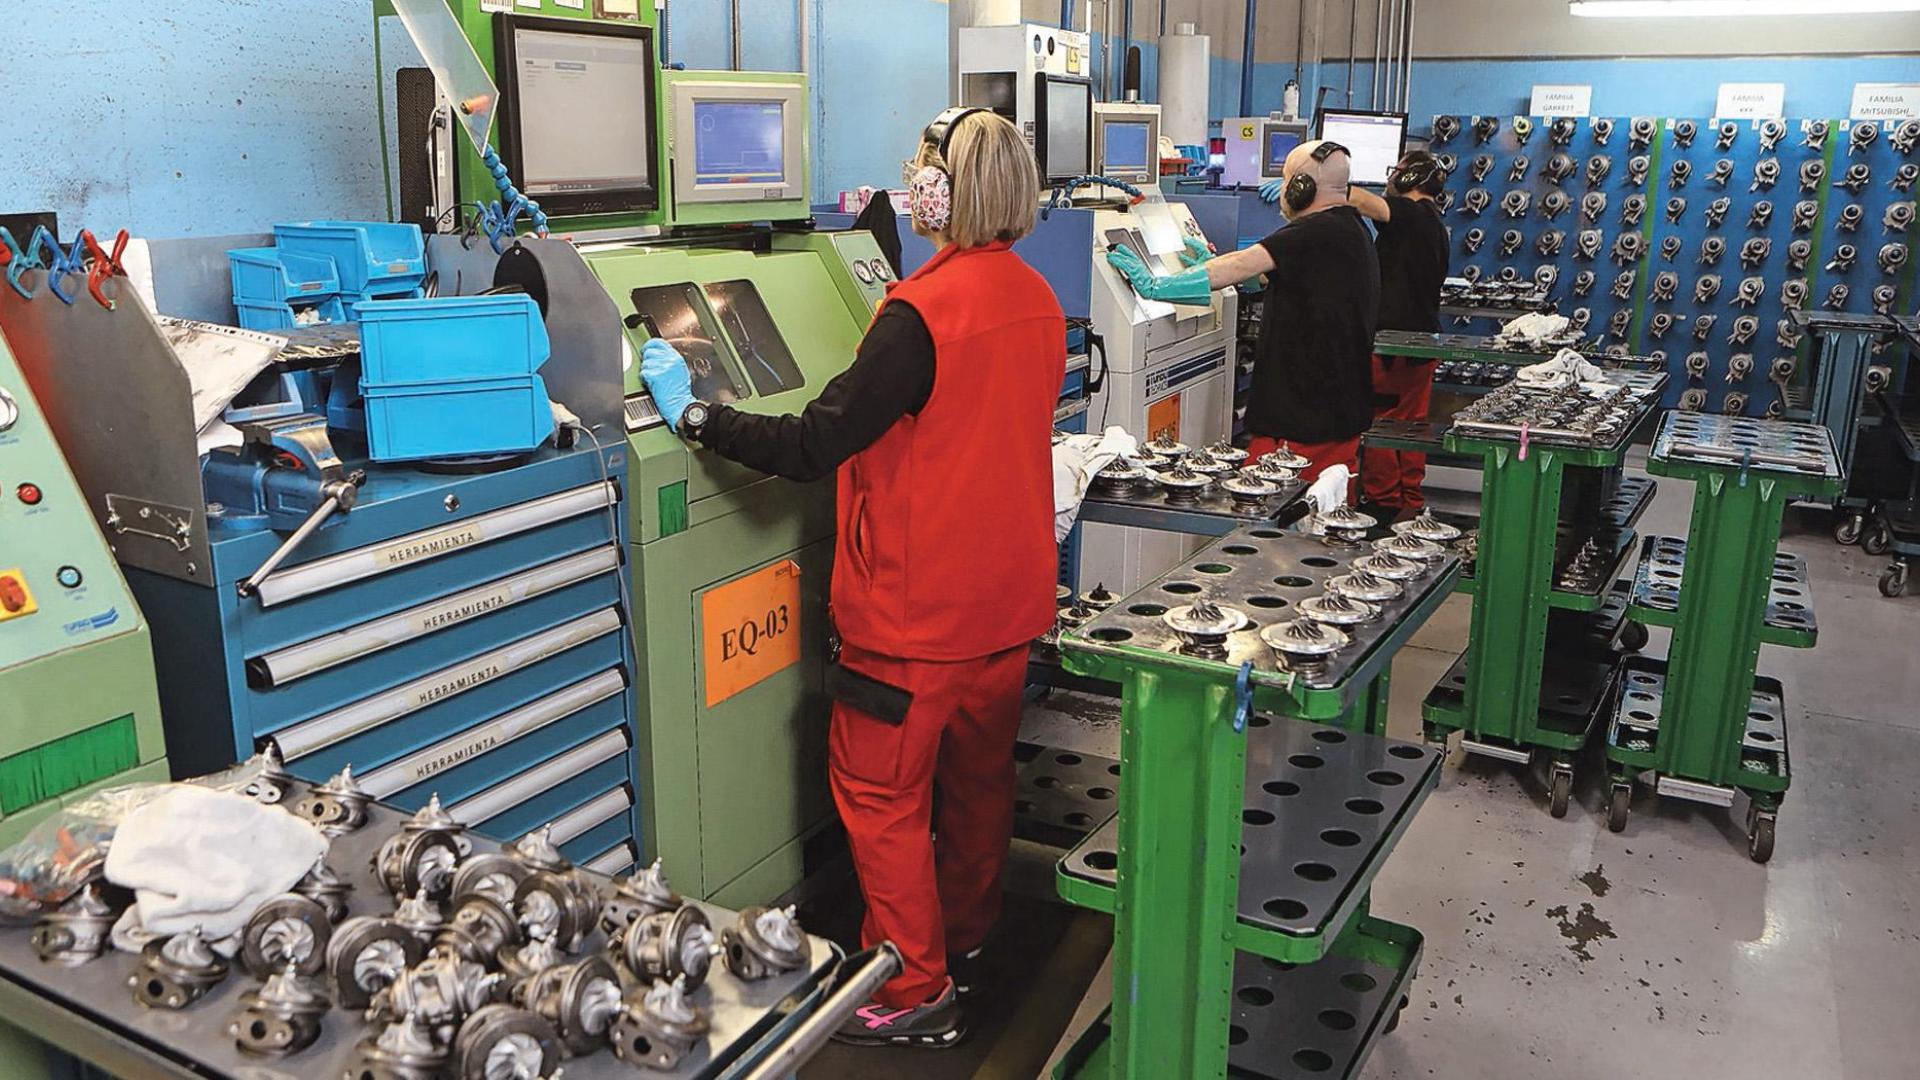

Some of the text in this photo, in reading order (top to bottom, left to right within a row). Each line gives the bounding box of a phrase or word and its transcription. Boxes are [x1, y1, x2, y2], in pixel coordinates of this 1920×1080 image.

[1859, 107, 1910, 116] MITSUBISHI
[1869, 95, 1904, 103] FAMILIA
[1242, 127, 1254, 137] CS
[388, 532, 475, 562] HERRAMIENTA
[423, 595, 505, 629] HERRAMIENTA
[721, 604, 789, 662] EQ-03
[418, 664, 500, 703] HERRAMIENTA
[416, 736, 497, 777] HERRAMIENTA
